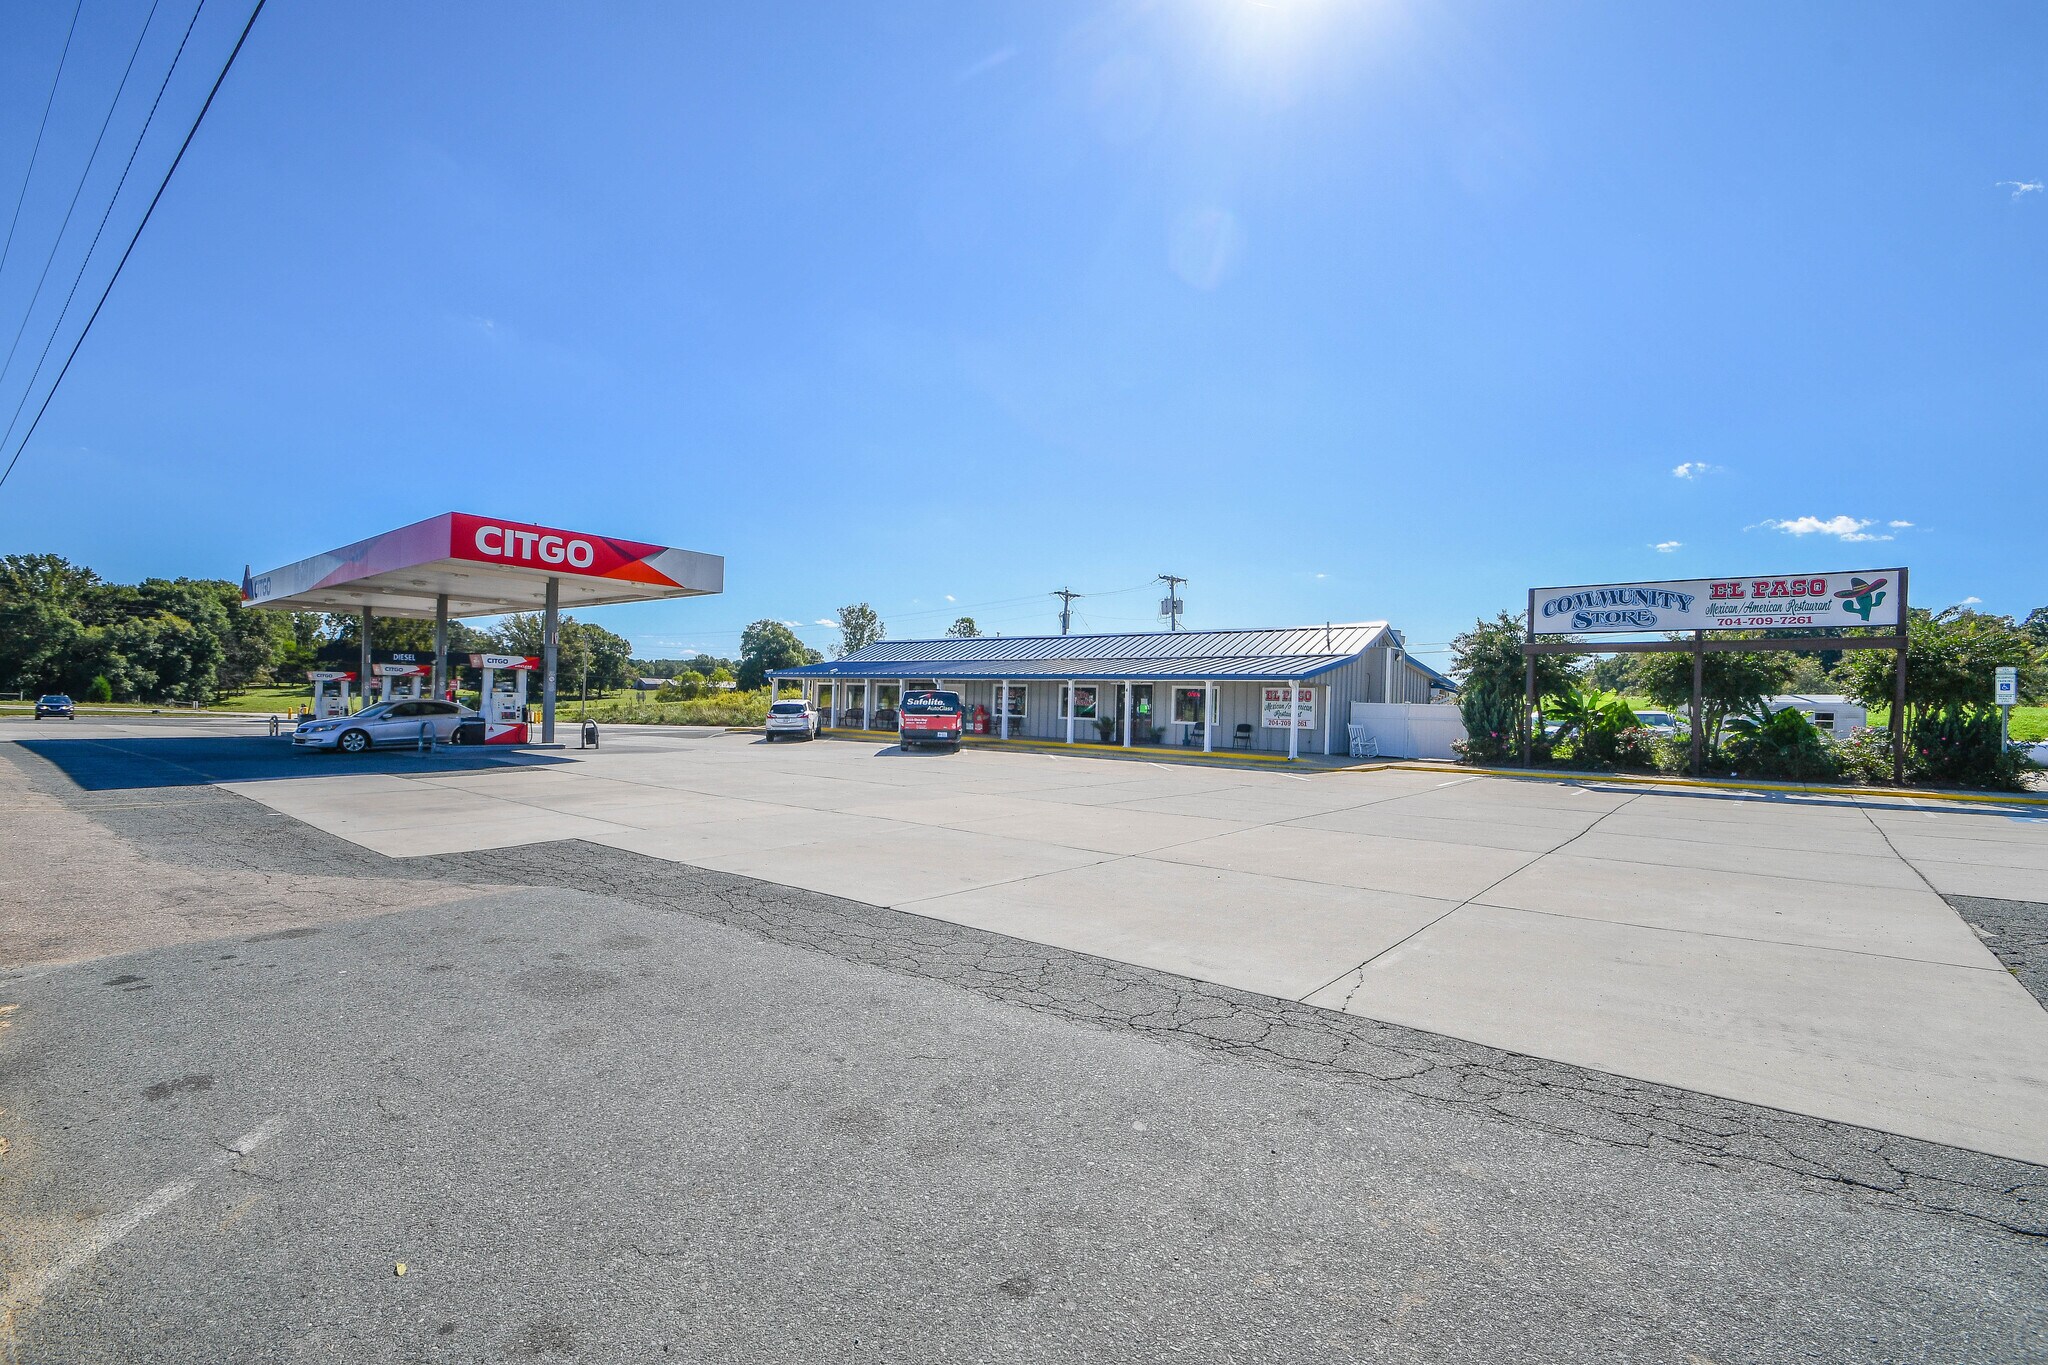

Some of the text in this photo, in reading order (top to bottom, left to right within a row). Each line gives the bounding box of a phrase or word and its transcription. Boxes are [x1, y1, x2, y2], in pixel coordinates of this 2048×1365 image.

[475, 525, 594, 568] CITGO
[254, 577, 272, 598] CITGO
[1709, 578, 1828, 600] EL PASO
[1542, 587, 1695, 618] COMMUNITY
[1705, 599, 1832, 616] Mexican/American Restaurant
[1572, 609, 1658, 630] STORE
[1717, 616, 1813, 626] 704-709-7261
[393, 653, 416, 661] DIESEL
[1265, 690, 1312, 702] EL PSO
